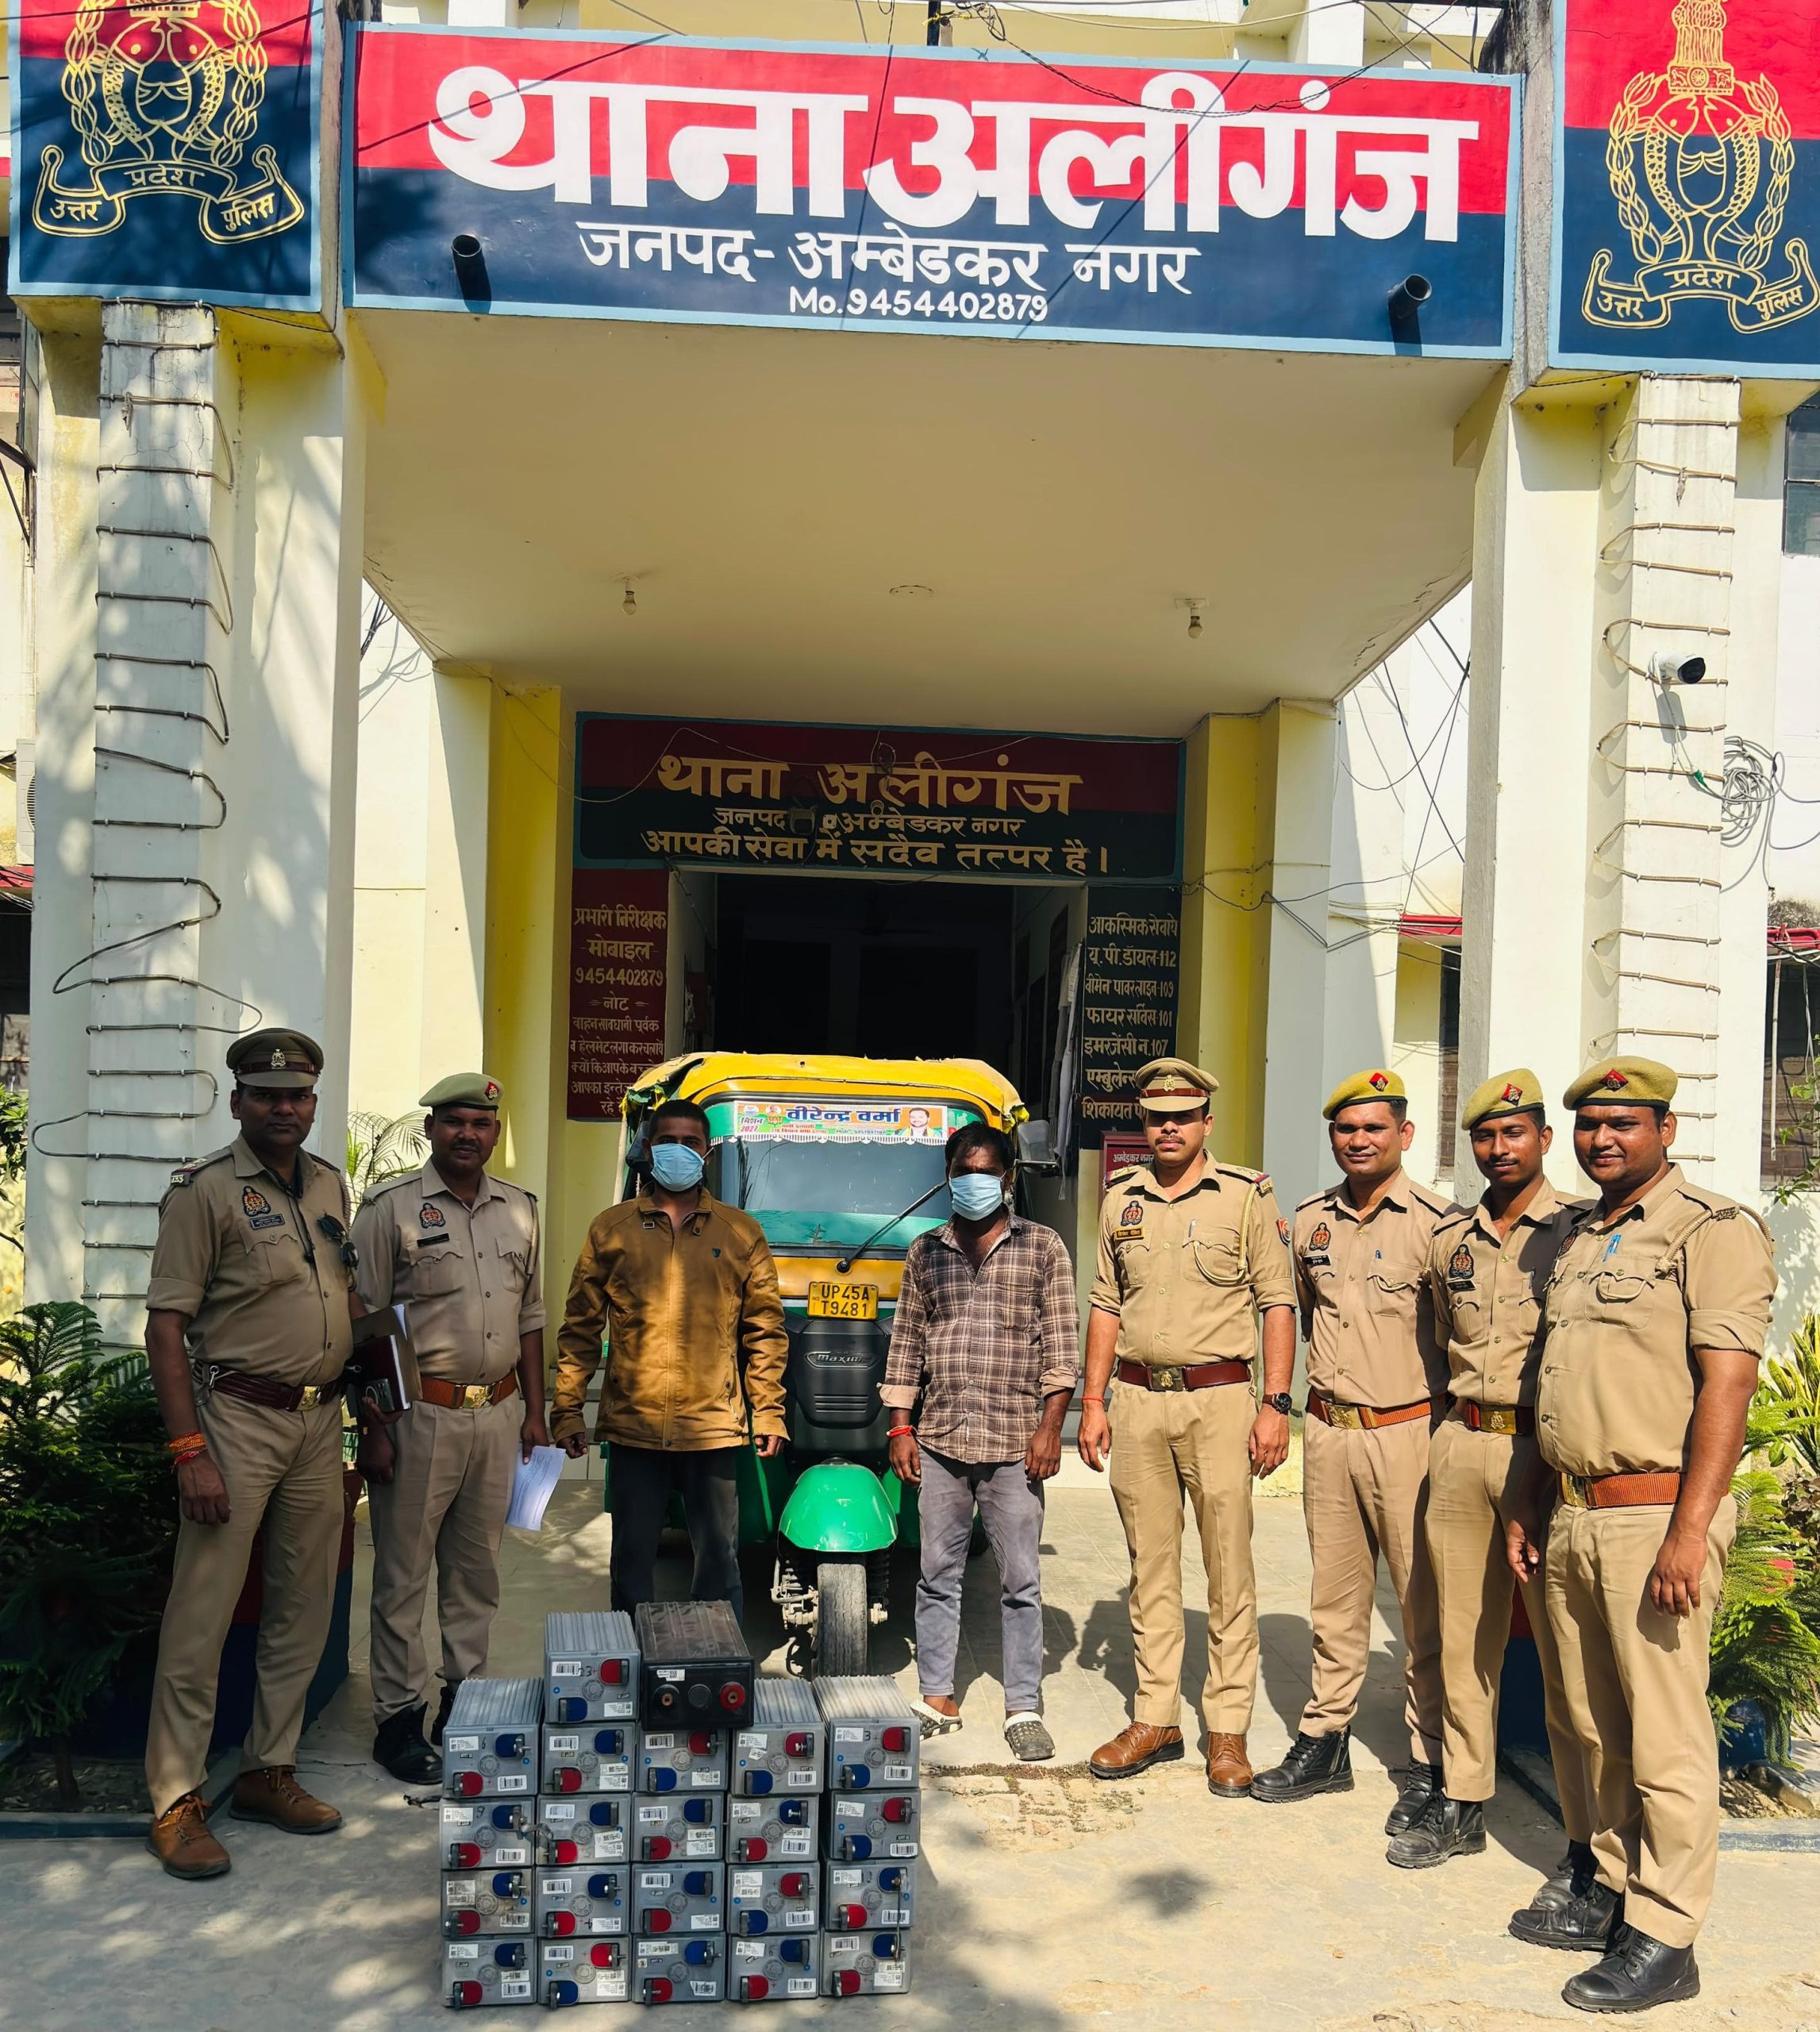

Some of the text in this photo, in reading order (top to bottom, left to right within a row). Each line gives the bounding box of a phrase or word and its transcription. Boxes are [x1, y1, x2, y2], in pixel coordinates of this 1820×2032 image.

[429, 65, 1479, 243] थाना अलीगंज
[124, 164, 205, 187] प्रदेश
[49, 191, 276, 233] उत्तर पुलिस
[787, 221, 1049, 292] अम्बेडकर
[1064, 242, 1203, 295] नगर
[1663, 264, 1741, 290] प्रदेश
[1596, 285, 1803, 321] उत्तर पुलिस
[657, 750, 1083, 816] थाना अलीगंज
[712, 806, 790, 831] जनपद
[971, 817, 1027, 838] नगर
[640, 826, 741, 858] आपकी
[743, 827, 808, 860] सेवा
[815, 827, 843, 860] में
[849, 833, 946, 867] सदैव
[955, 843, 1052, 873] तत्पर
[573, 903, 614, 927] प्रभारी
[586, 933, 655, 963] मोबाइल
[575, 967, 664, 987] 9454402879
[602, 991, 629, 1011] नोट
[1085, 1007, 1126, 1027] फायर
[786, 1106, 902, 1122] वीरेन्द्र वर्मा
[1081, 1096, 1133, 1120] शिकायत
[821, 1284, 869, 1301] UP45A
[821, 1300, 868, 1317] T9481
